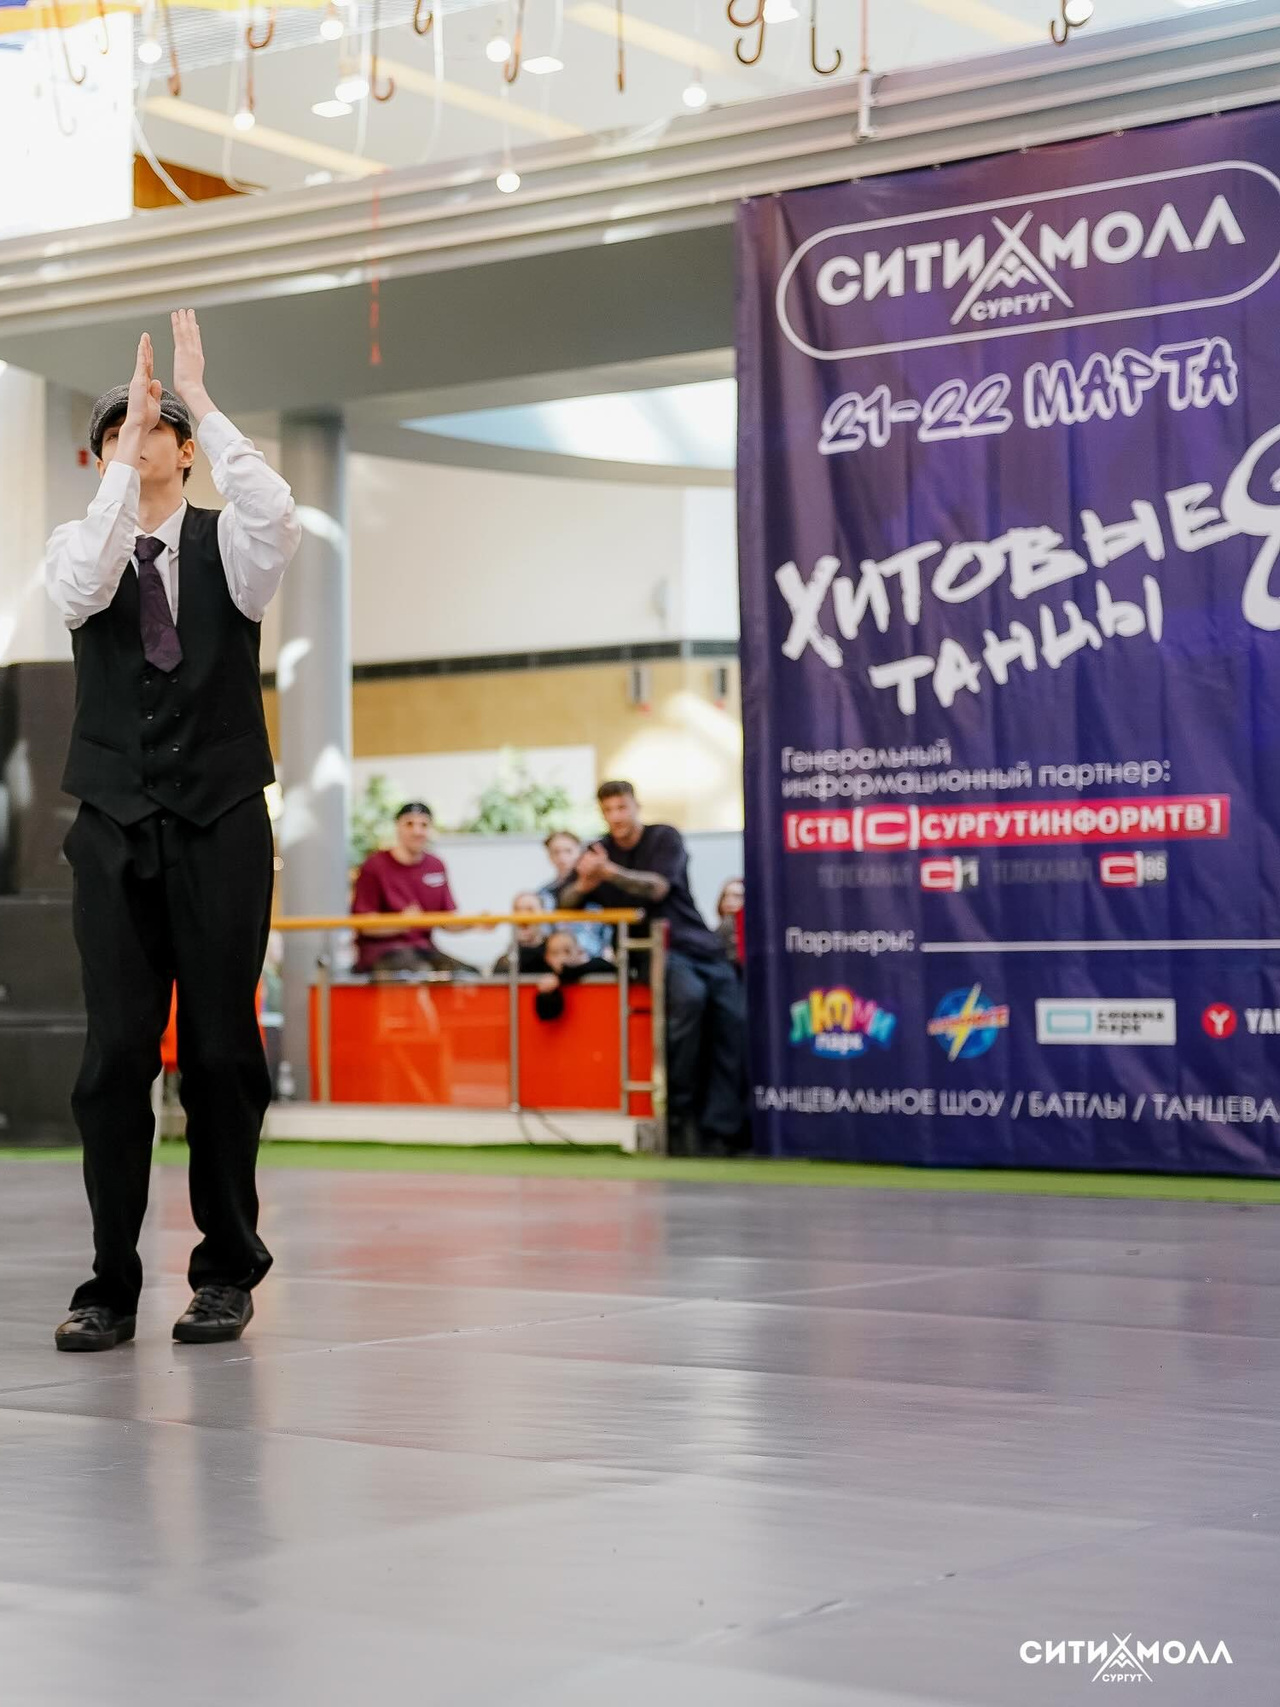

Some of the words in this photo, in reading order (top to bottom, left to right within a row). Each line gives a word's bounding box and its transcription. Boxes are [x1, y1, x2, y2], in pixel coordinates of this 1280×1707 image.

[970, 290, 1053, 321] СУРГУТ
[818, 373, 1014, 455] 21-22
[1023, 336, 1238, 429] МАРТА
[774, 482, 1232, 668] ХИТОВЫЕ
[867, 575, 1163, 715] ТАНЦЫ
[781, 738, 952, 773] Генеральный
[781, 761, 1033, 802] информационный
[1038, 760, 1171, 791] партнер:
[785, 927, 915, 957] Партнеры:
[754, 1086, 936, 1115] ТАНЦЕВАЛЬНОЕ
[939, 1089, 1007, 1117] ШОУ
[1028, 1091, 1127, 1120] БАТТЛЫ
